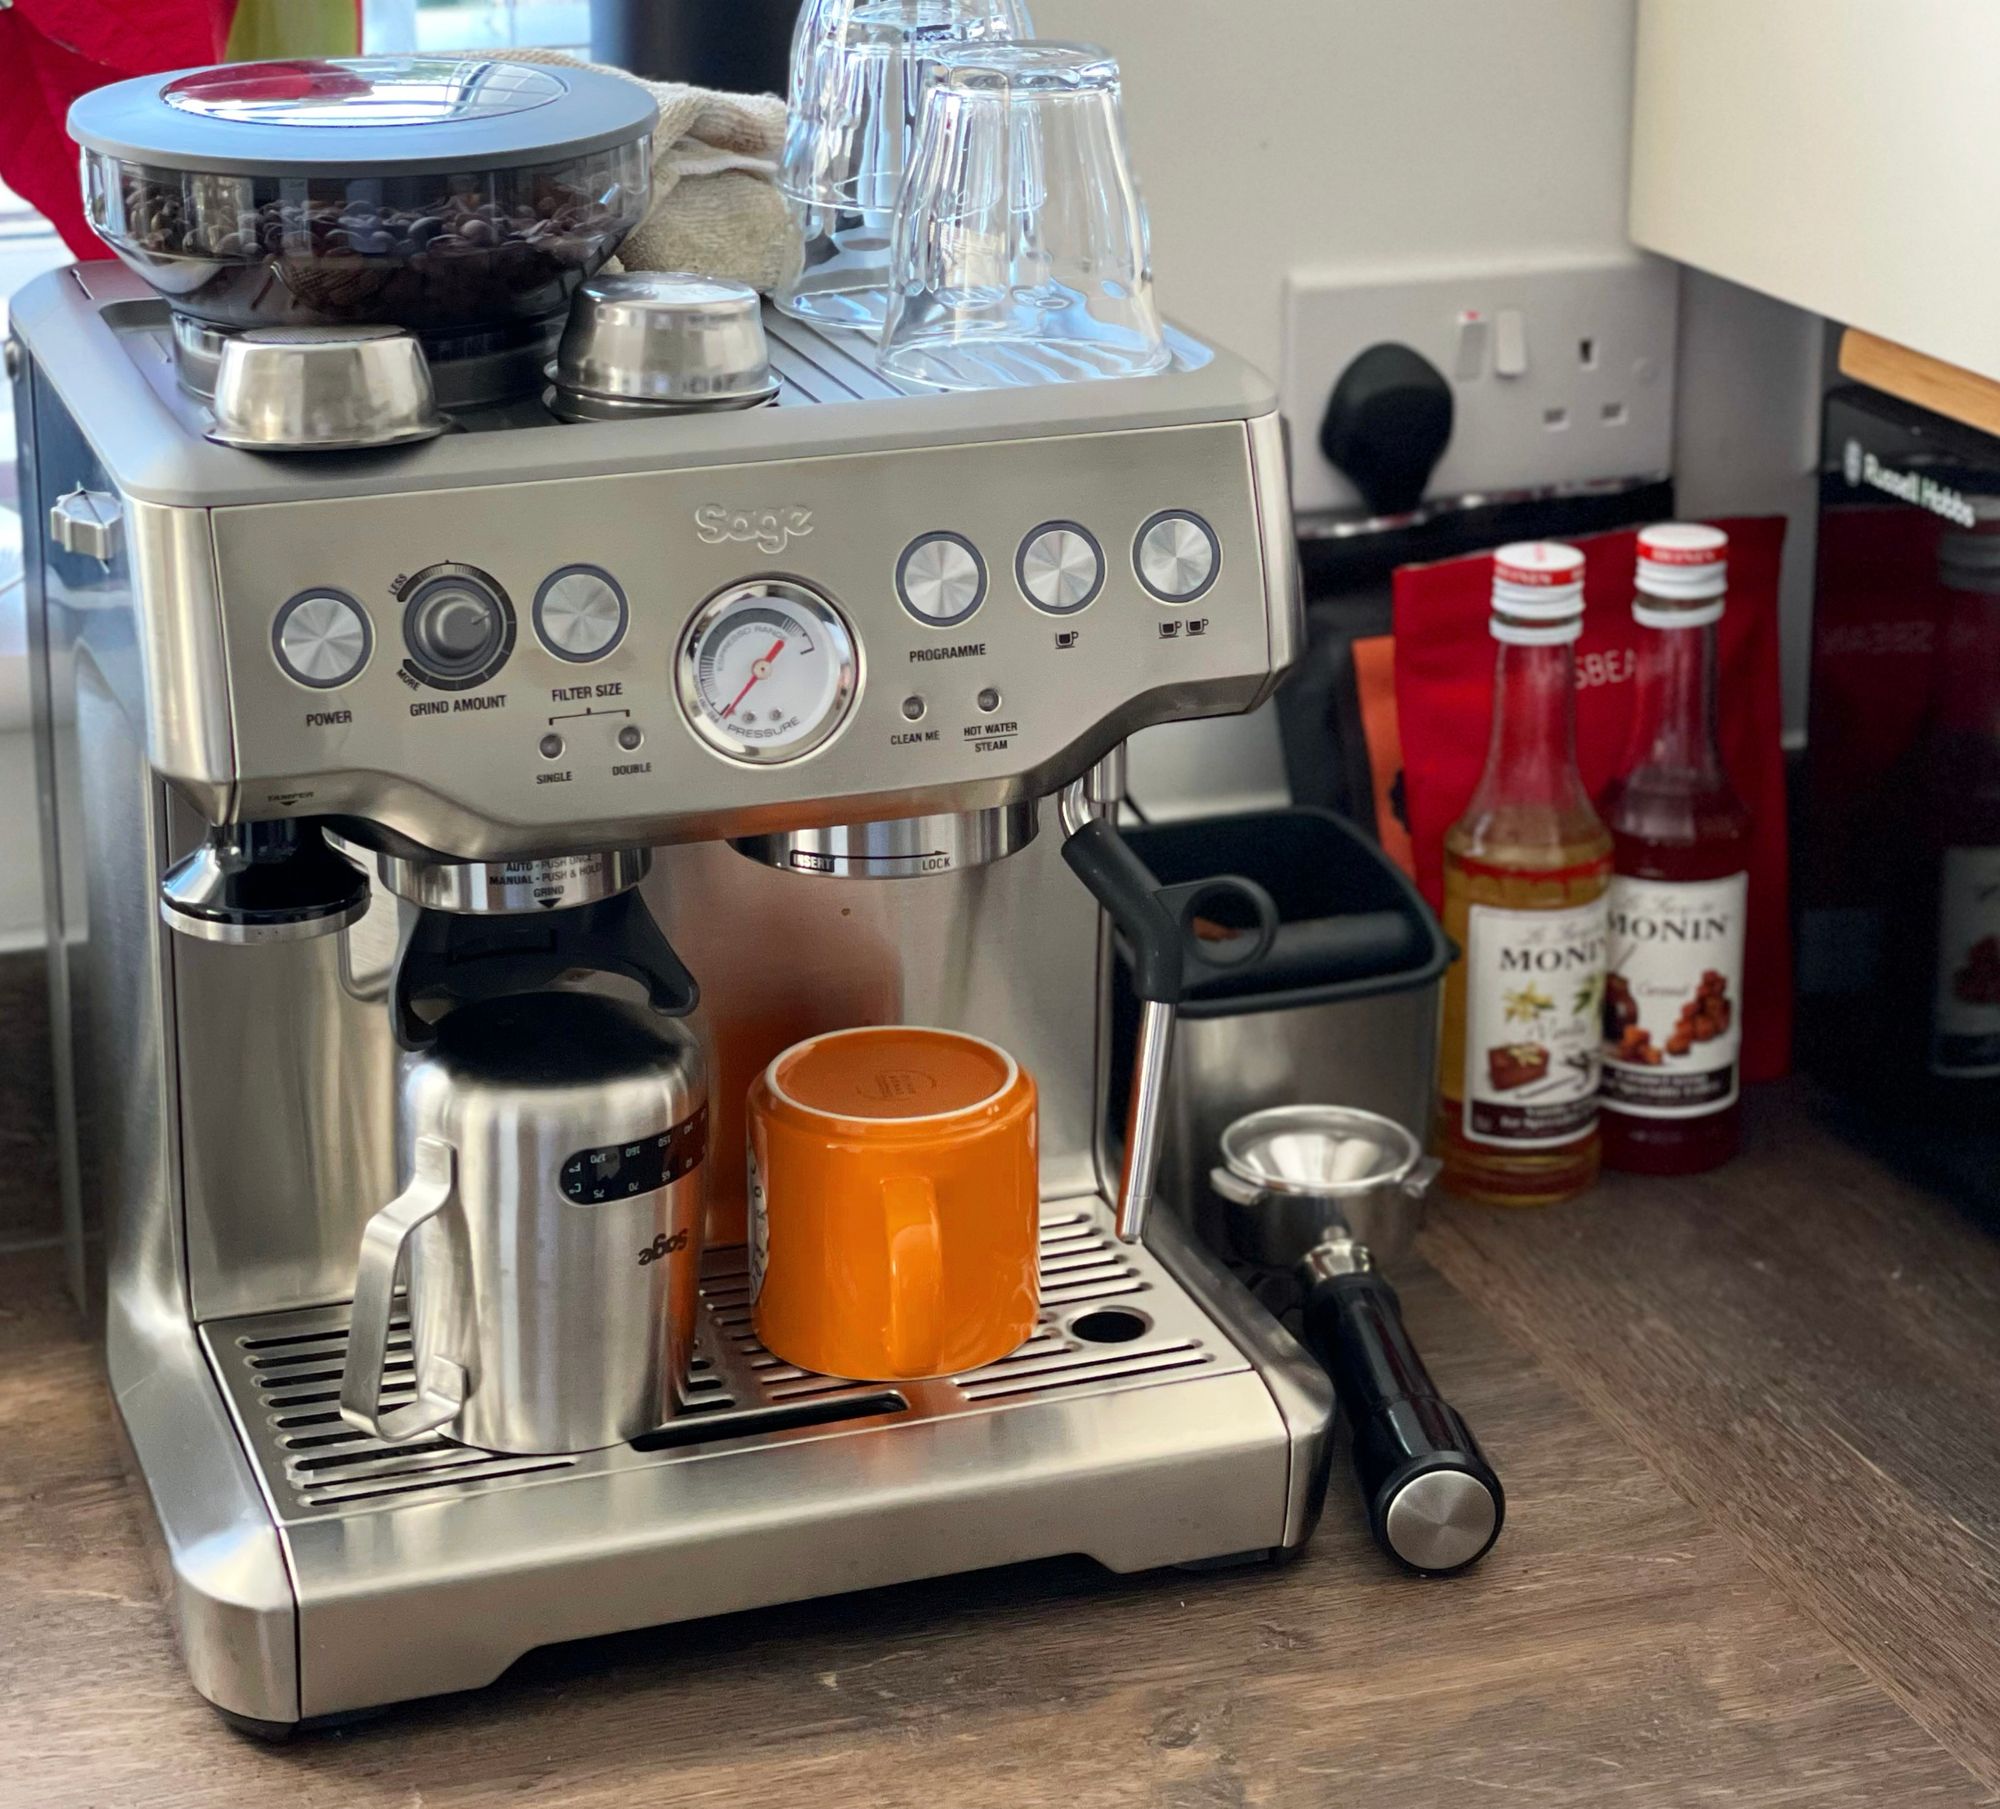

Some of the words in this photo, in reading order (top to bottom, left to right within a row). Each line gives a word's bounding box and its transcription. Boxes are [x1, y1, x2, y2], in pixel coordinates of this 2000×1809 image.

[694, 503, 814, 554] Sage
[388, 573, 408, 596] LESS
[909, 643, 986, 663] PROGRAMME
[396, 669, 421, 691] MORE
[551, 685, 593, 702] FILTER
[596, 682, 623, 697] SIZE
[410, 701, 449, 717] GRIND
[453, 694, 507, 714] AMOUNT
[306, 710, 352, 727] POWER
[727, 716, 801, 739] PRESSURE
[964, 725, 983, 737] HOT
[985, 722, 1018, 735] WATER
[890, 732, 922, 746] CLEAN
[925, 730, 940, 742] ME
[975, 740, 1008, 753] STEAM
[612, 762, 652, 777] DOUBLE
[536, 771, 572, 785] SINGLE
[506, 862, 533, 872] AUTO
[793, 853, 832, 869] INSERT
[922, 856, 950, 870] LOCK
[489, 876, 533, 886] MANUAL
[542, 871, 567, 882] PUSH
[534, 885, 564, 898] GRIND
[590, 1152, 607, 1164] 170
[625, 1145, 640, 1158] 160
[658, 1135, 671, 1148] 150
[593, 1188, 605, 1199] 75
[628, 1181, 639, 1192] 70
